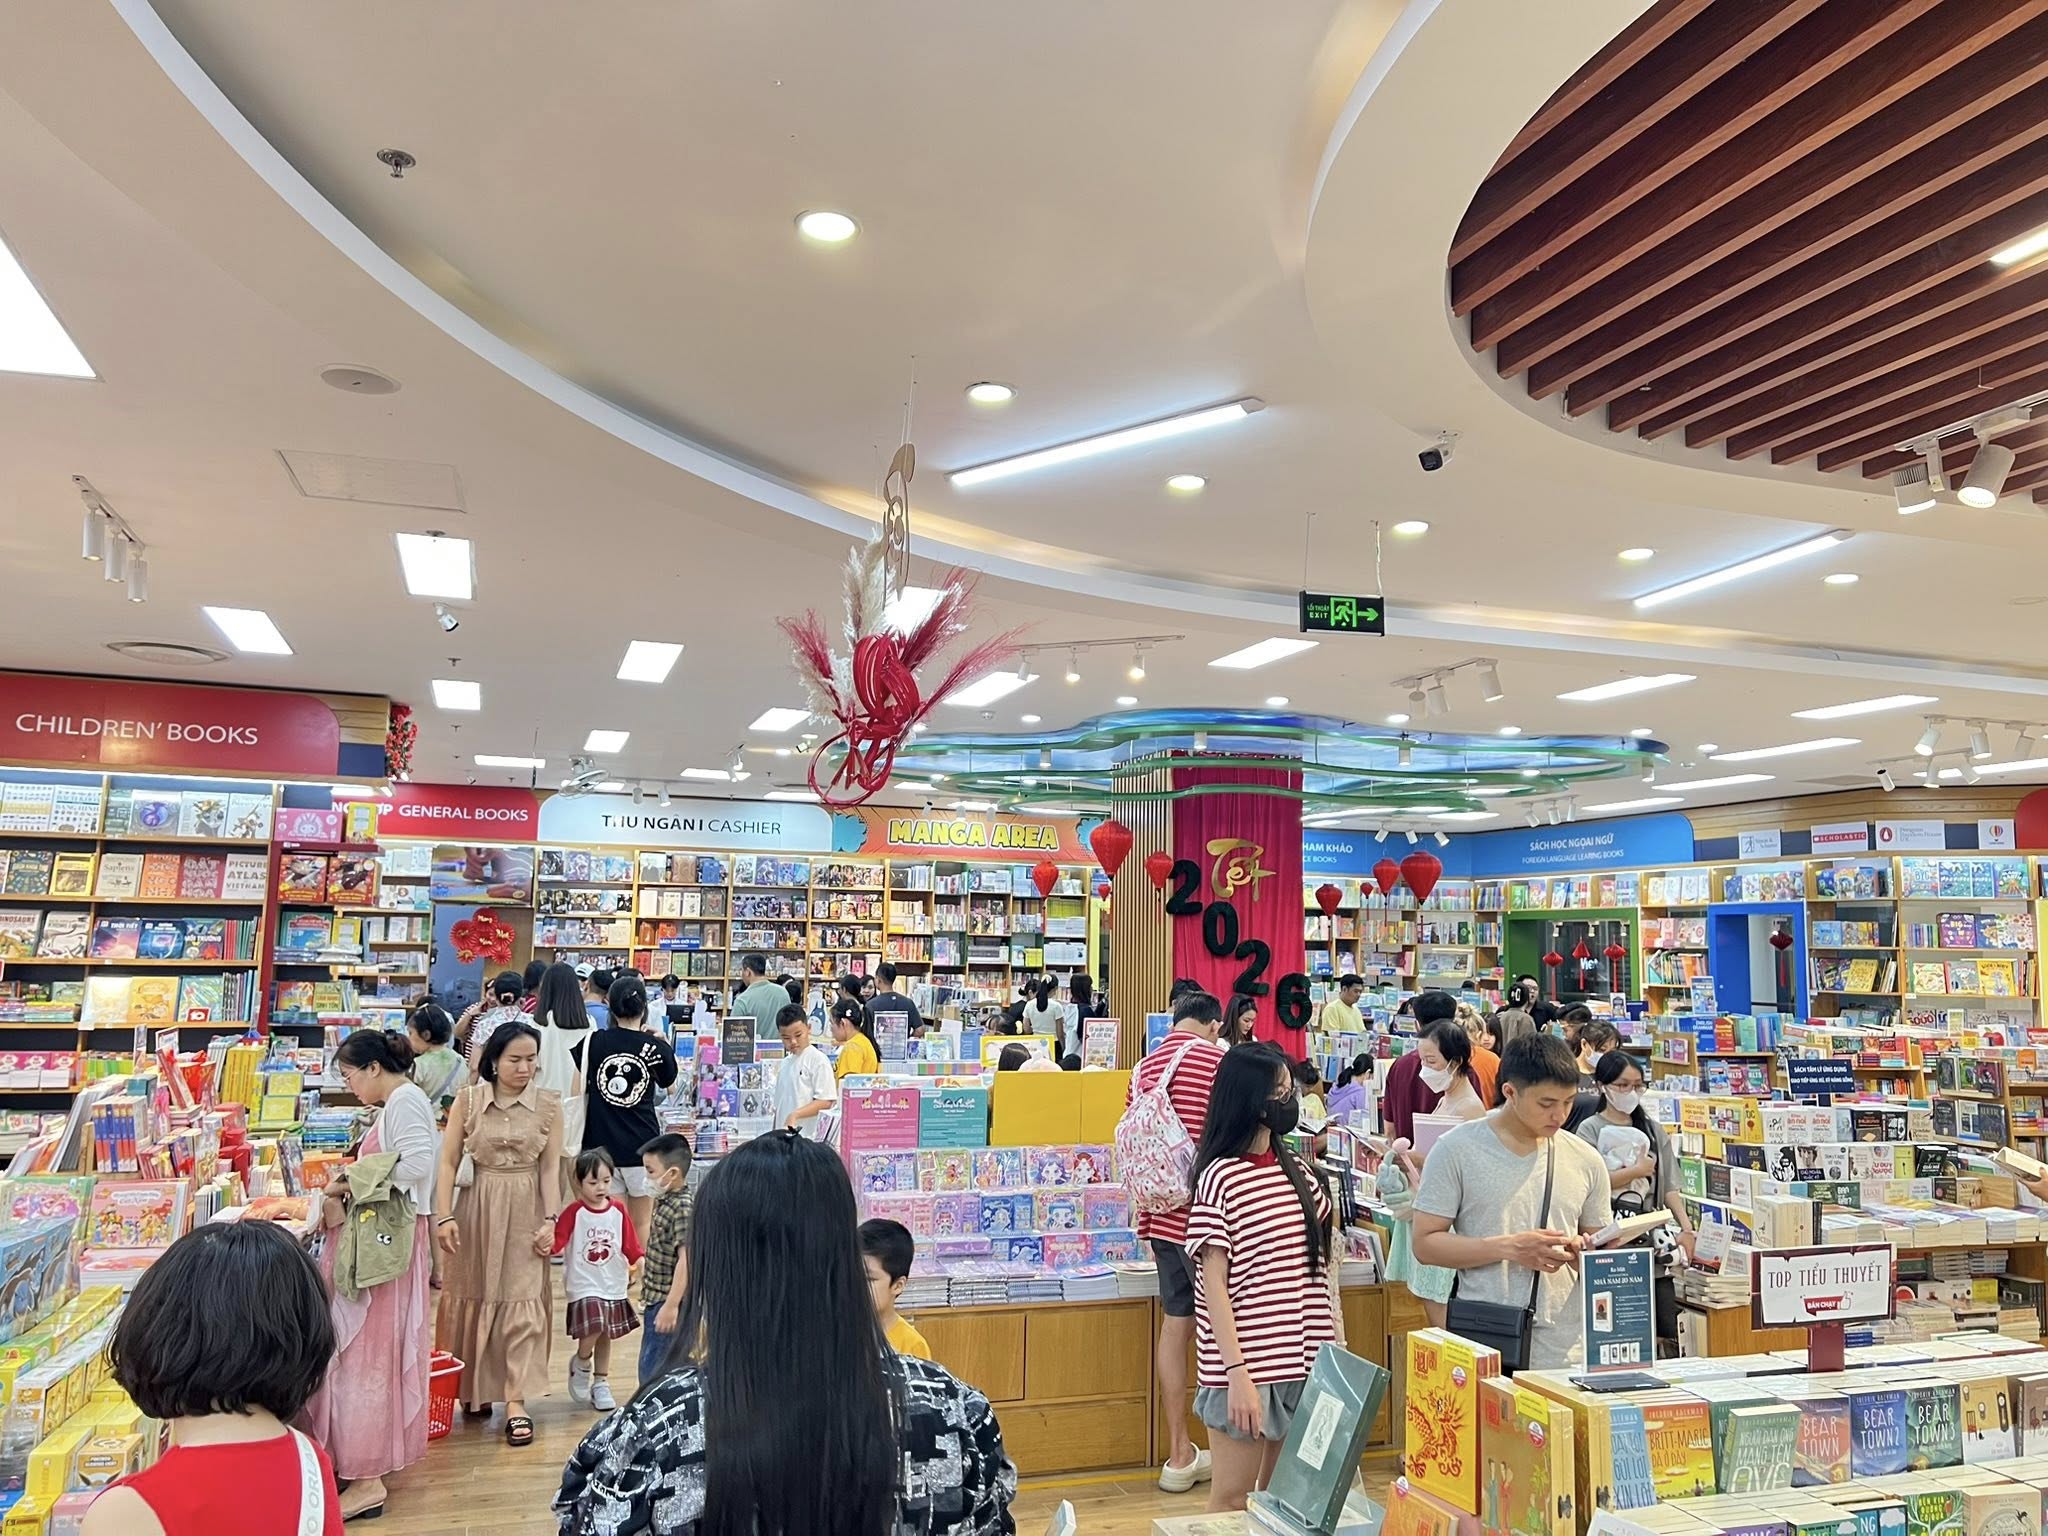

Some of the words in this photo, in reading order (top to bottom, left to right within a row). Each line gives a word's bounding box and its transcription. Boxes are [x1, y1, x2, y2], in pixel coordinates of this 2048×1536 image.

[167, 723, 259, 746] BOOKS
[399, 804, 472, 821] GENERAL
[475, 809, 529, 822] BOOKS
[644, 813, 695, 832] NGÂN
[708, 818, 781, 835] CASHIER
[889, 819, 987, 848] MANGA
[991, 825, 1060, 850] AREA
[1820, 832, 1866, 842] SCHOLASTIC
[1303, 842, 1324, 852] HAM
[1530, 840, 1549, 851] SÁCH
[1522, 856, 1546, 864] FOREIGN
[1546, 854, 1577, 863] LANGUAGE
[1603, 849, 1624, 858] BOOKS
[227, 871, 266, 880] ATLAS
[226, 882, 264, 890] VIETNAM
[1794, 1065, 1806, 1073] SÁCH
[1768, 1271, 1792, 1289] TOP
[1799, 1262, 1827, 1286] TIỂU
[1834, 1259, 1884, 1285] THUYẾT
[1821, 1299, 1837, 1310] CHẠY
[1863, 1407, 1895, 1430] BEAR
[1918, 1403, 1949, 1425] BEAR
[1803, 1415, 1838, 1438] BEAR
[1915, 1425, 1949, 1445] TOWN
[1649, 1427, 1710, 1451] BRITT-MARIE
[1803, 1438, 1840, 1457] TOWN
[1860, 1430, 1893, 1450] TOWN
[1894, 1428, 1900, 1447] 2
